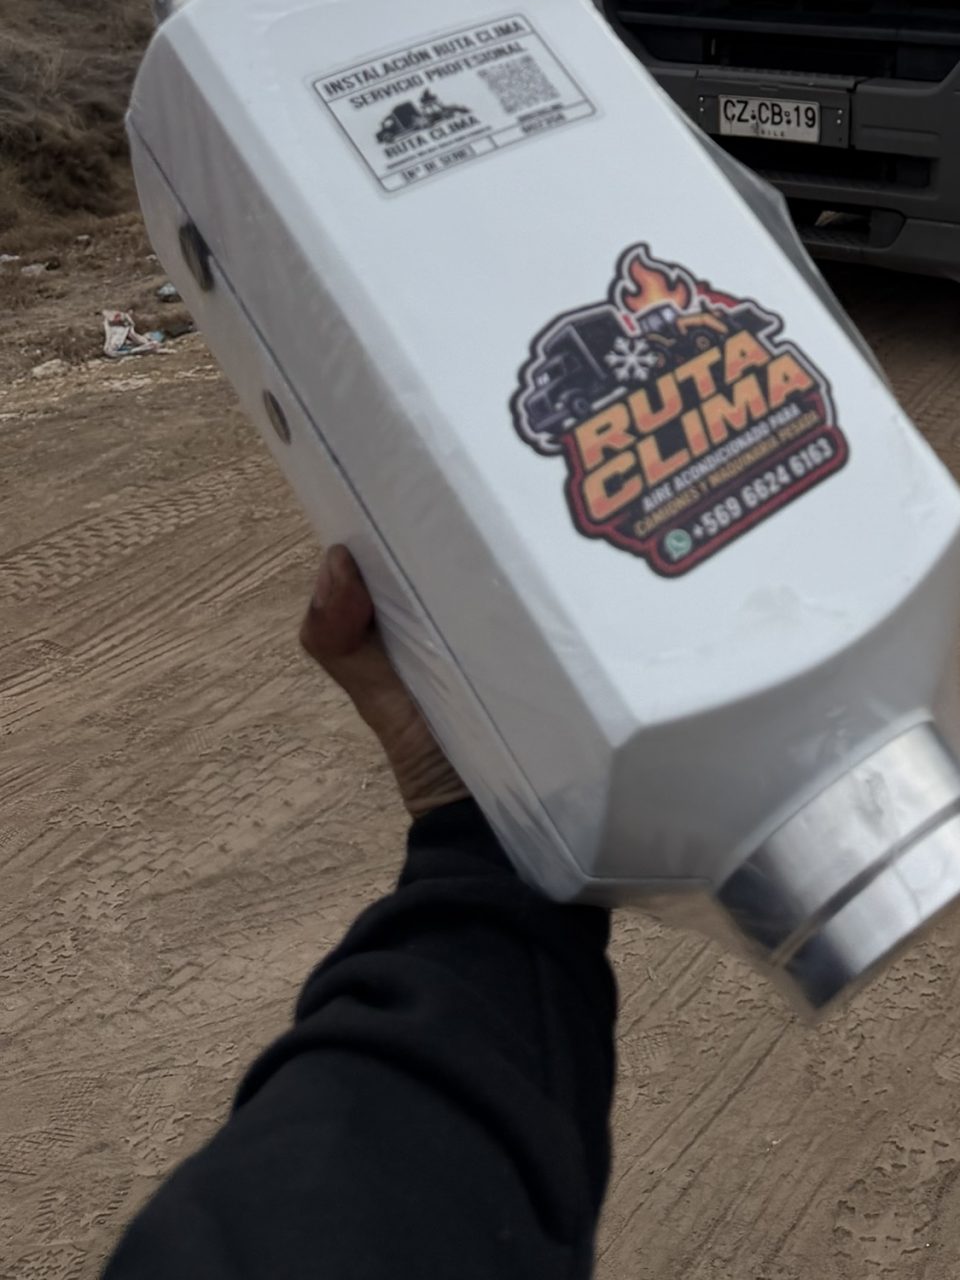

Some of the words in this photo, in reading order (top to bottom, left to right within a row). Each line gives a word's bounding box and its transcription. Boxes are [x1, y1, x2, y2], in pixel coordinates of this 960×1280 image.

[323, 47, 430, 96] INSTALACIÓN
[432, 35, 475, 58] RUTA
[476, 20, 525, 44] CLIMA
[350, 75, 424, 109] SERVICIO
[425, 41, 527, 83] PROFESIONAL
[384, 135, 427, 159] RUTA
[429, 116, 481, 141] CLIMA
[574, 329, 770, 470] RUTA
[582, 352, 814, 521] CLIMA
[642, 481, 674, 512] AIRE
[673, 421, 771, 492] ACONDICIONADO
[692, 495, 743, 540] +569
[741, 464, 791, 508] 6624
[788, 437, 834, 477] 6163
